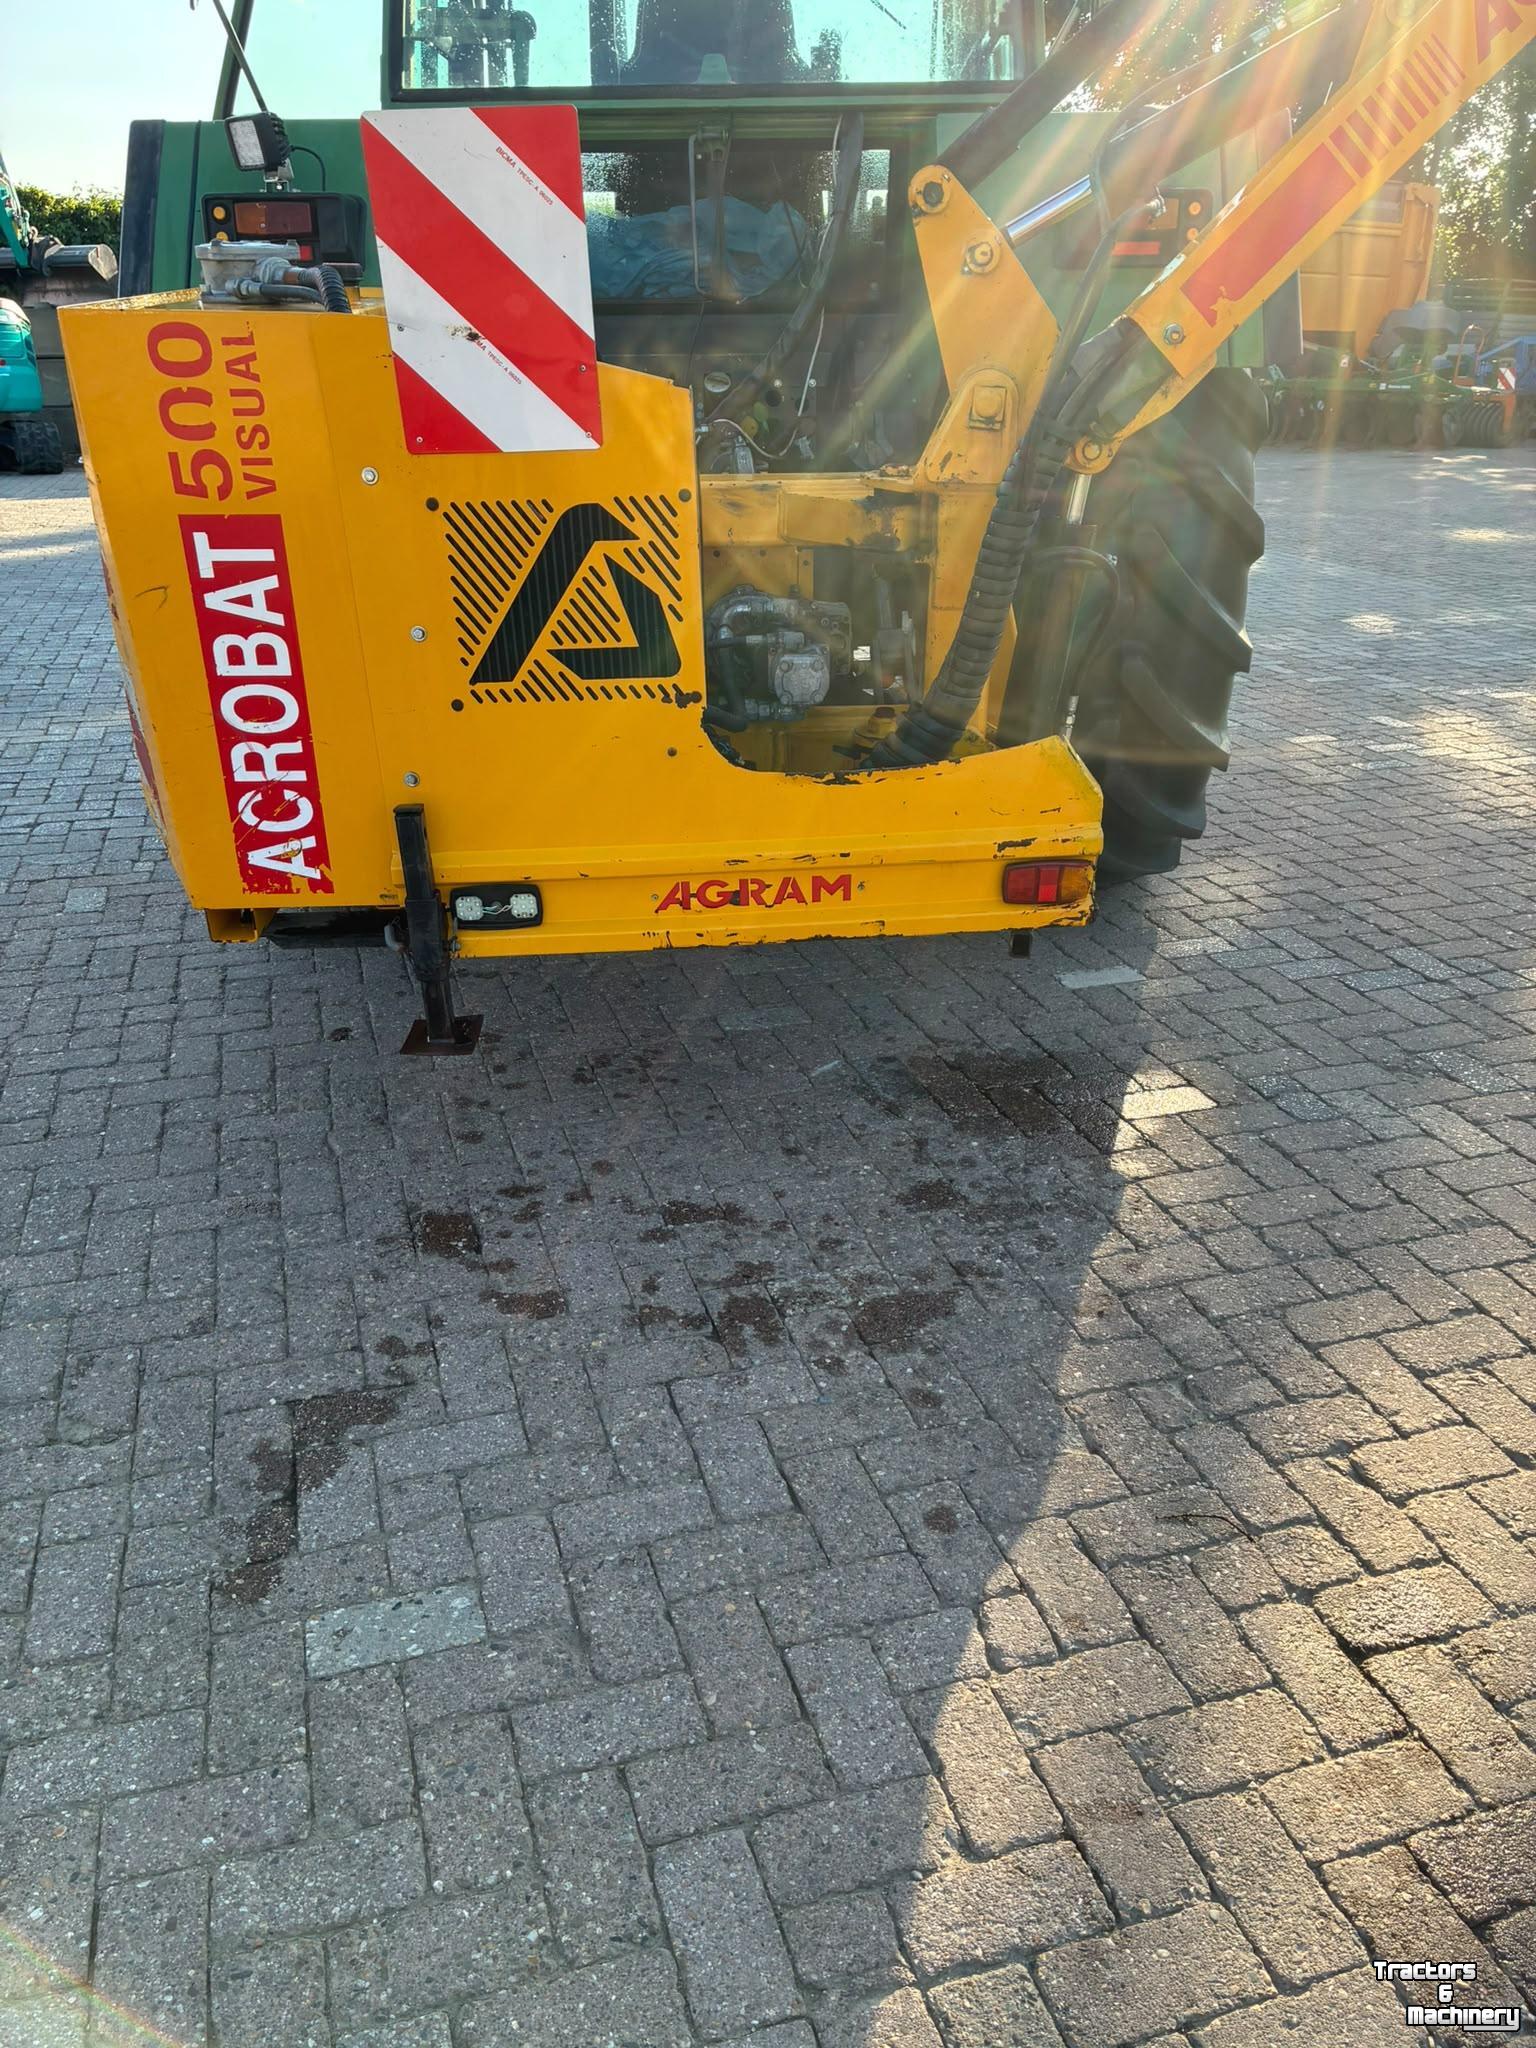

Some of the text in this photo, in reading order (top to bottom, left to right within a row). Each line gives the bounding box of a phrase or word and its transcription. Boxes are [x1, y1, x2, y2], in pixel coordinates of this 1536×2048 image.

[221, 328, 277, 500] VISUAL
[147, 321, 321, 880] ACROBAT 500
[655, 874, 852, 913] AGRAM
